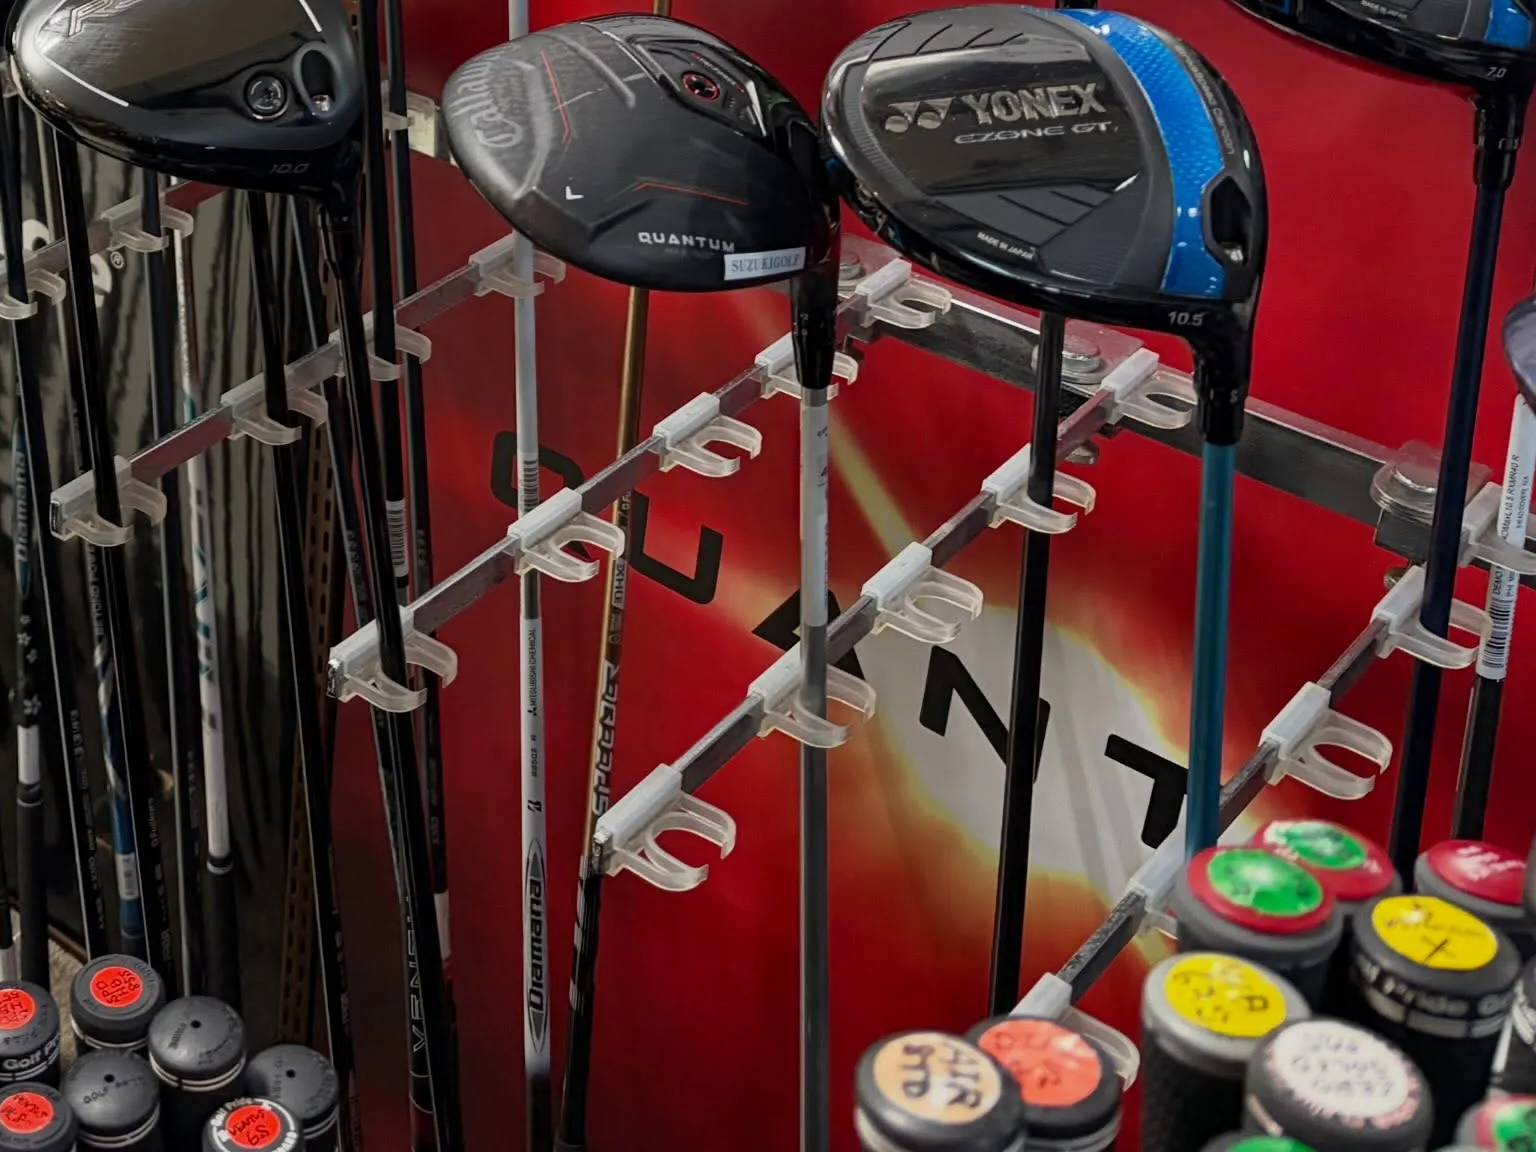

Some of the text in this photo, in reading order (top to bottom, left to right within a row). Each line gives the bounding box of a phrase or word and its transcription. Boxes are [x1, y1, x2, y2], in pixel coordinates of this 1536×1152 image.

[962, 82, 1107, 125] YONEX
[955, 127, 1064, 145] EZONE
[638, 231, 735, 252] QUANTUM
[731, 253, 801, 273] SUZUKIGOLF
[1168, 310, 1204, 327] 10.5
[528, 627, 538, 707] MITSUBISHI CHEMICAL
[591, 659, 619, 815] SPEEDER
[527, 878, 545, 1013] Diamana
[2, 1054, 41, 1070] Golf
